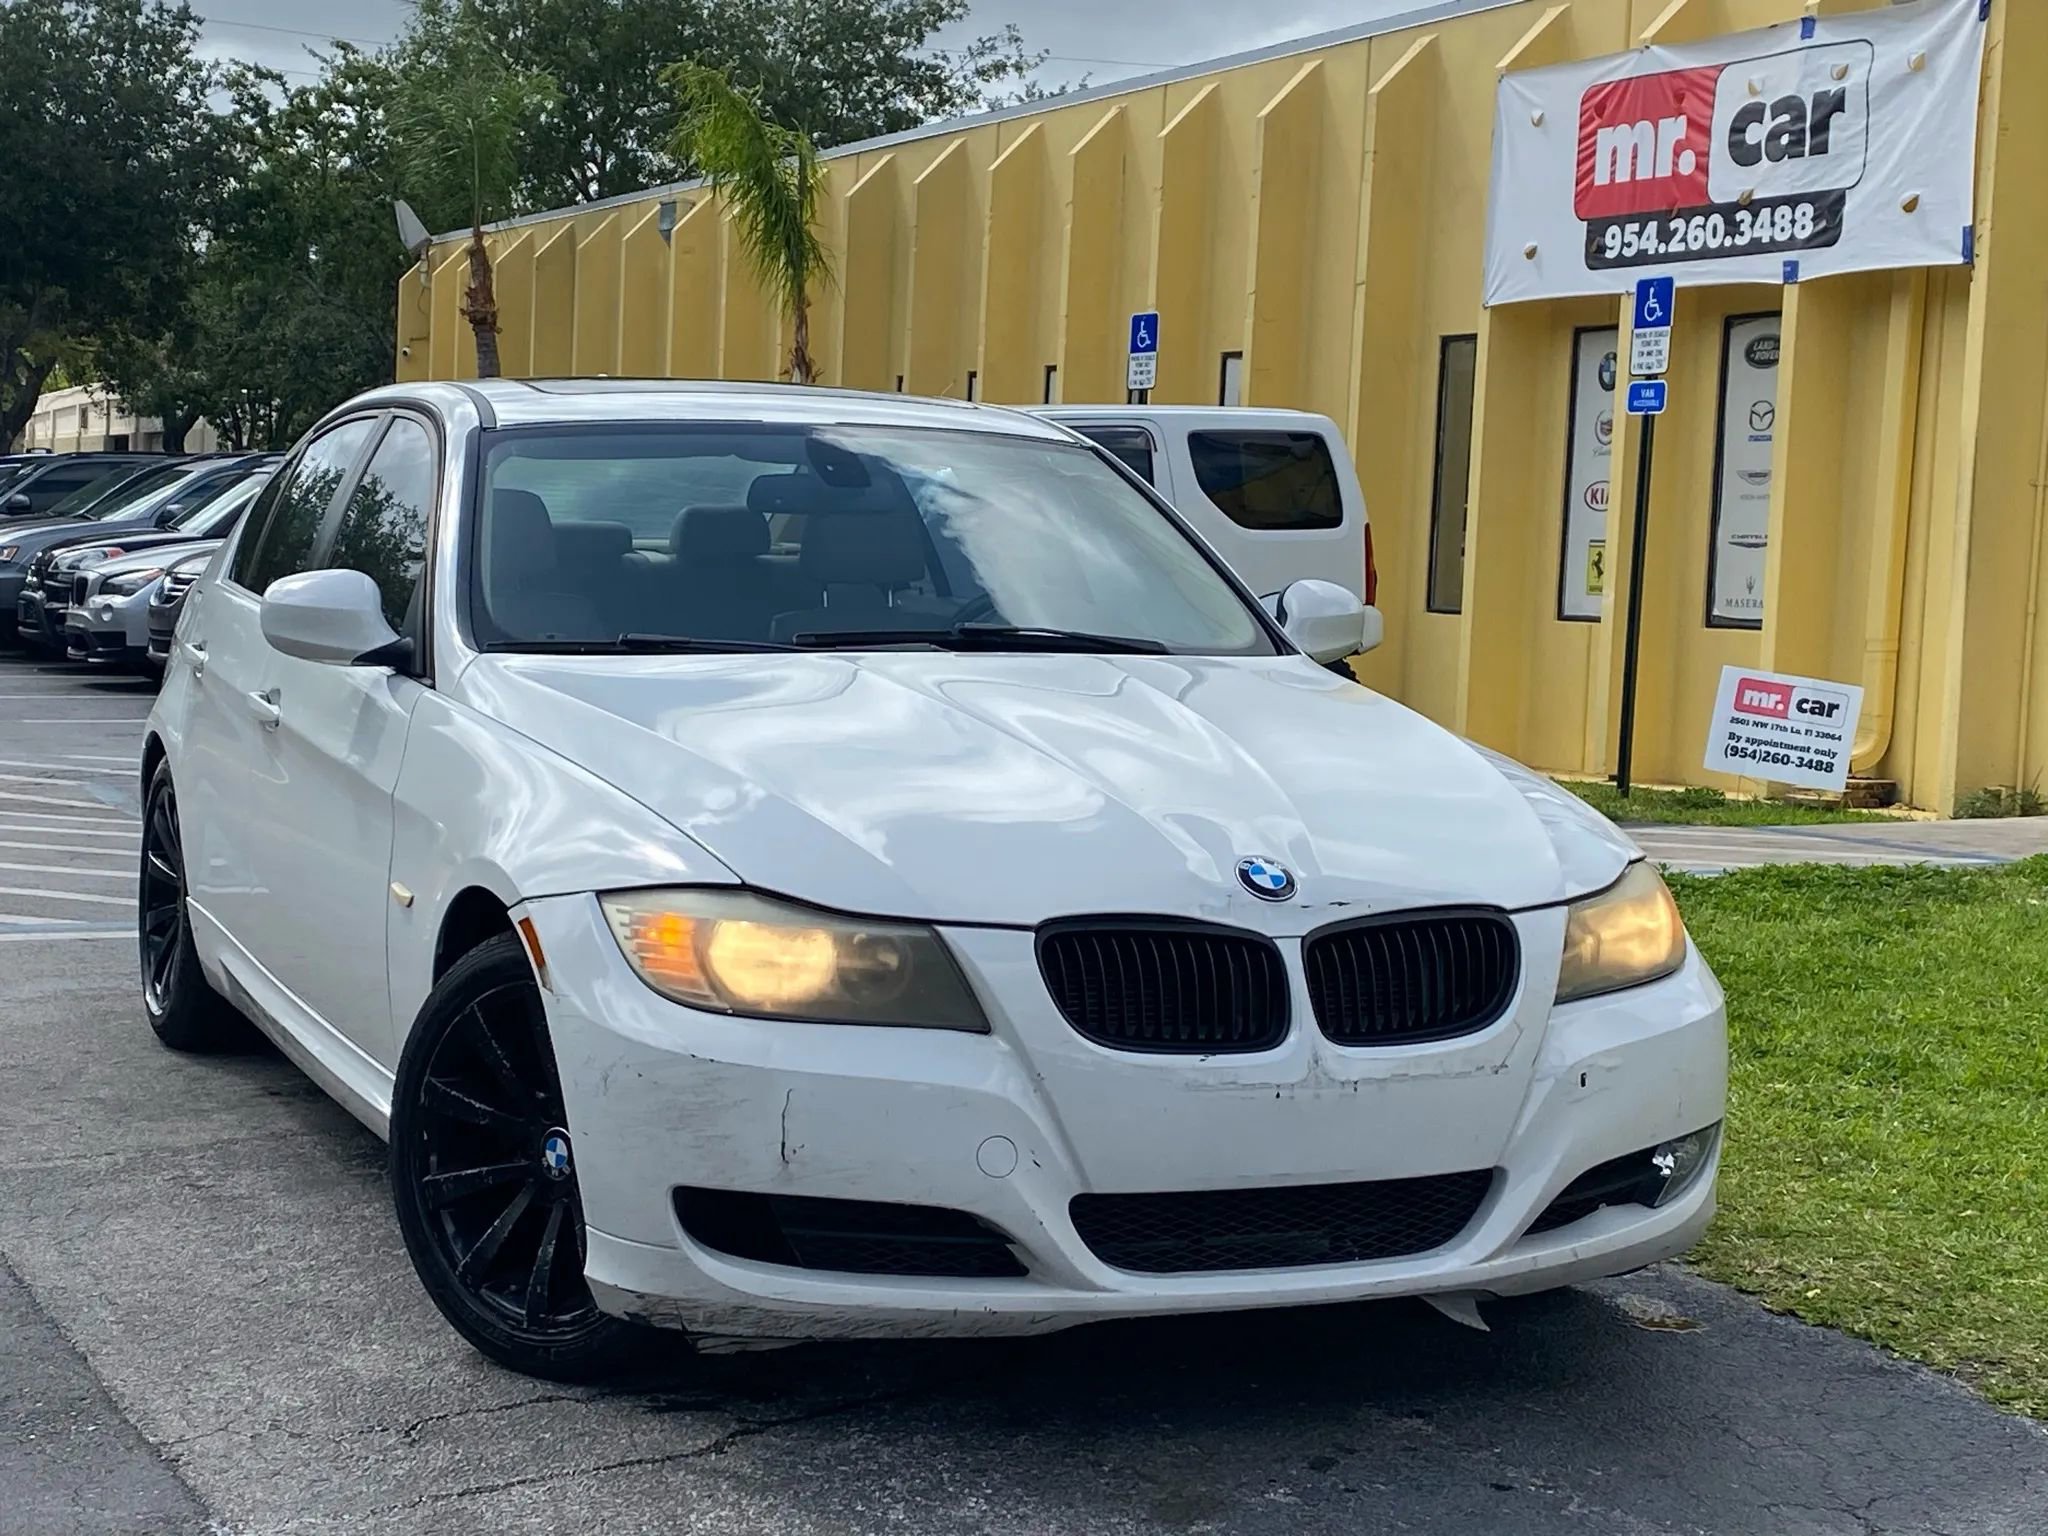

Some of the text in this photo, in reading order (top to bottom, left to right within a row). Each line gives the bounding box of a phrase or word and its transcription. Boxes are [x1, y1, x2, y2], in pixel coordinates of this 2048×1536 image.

[1594, 86, 1846, 186] mr. car
[1603, 203, 1814, 260] 954.260.3488
[1742, 688, 1840, 718] mr. car
[1729, 716, 1750, 726] 2501
[1752, 720, 1769, 729] NW
[1724, 743, 1835, 774] (954)260-3488
[1728, 731, 1838, 760] By appointment only
